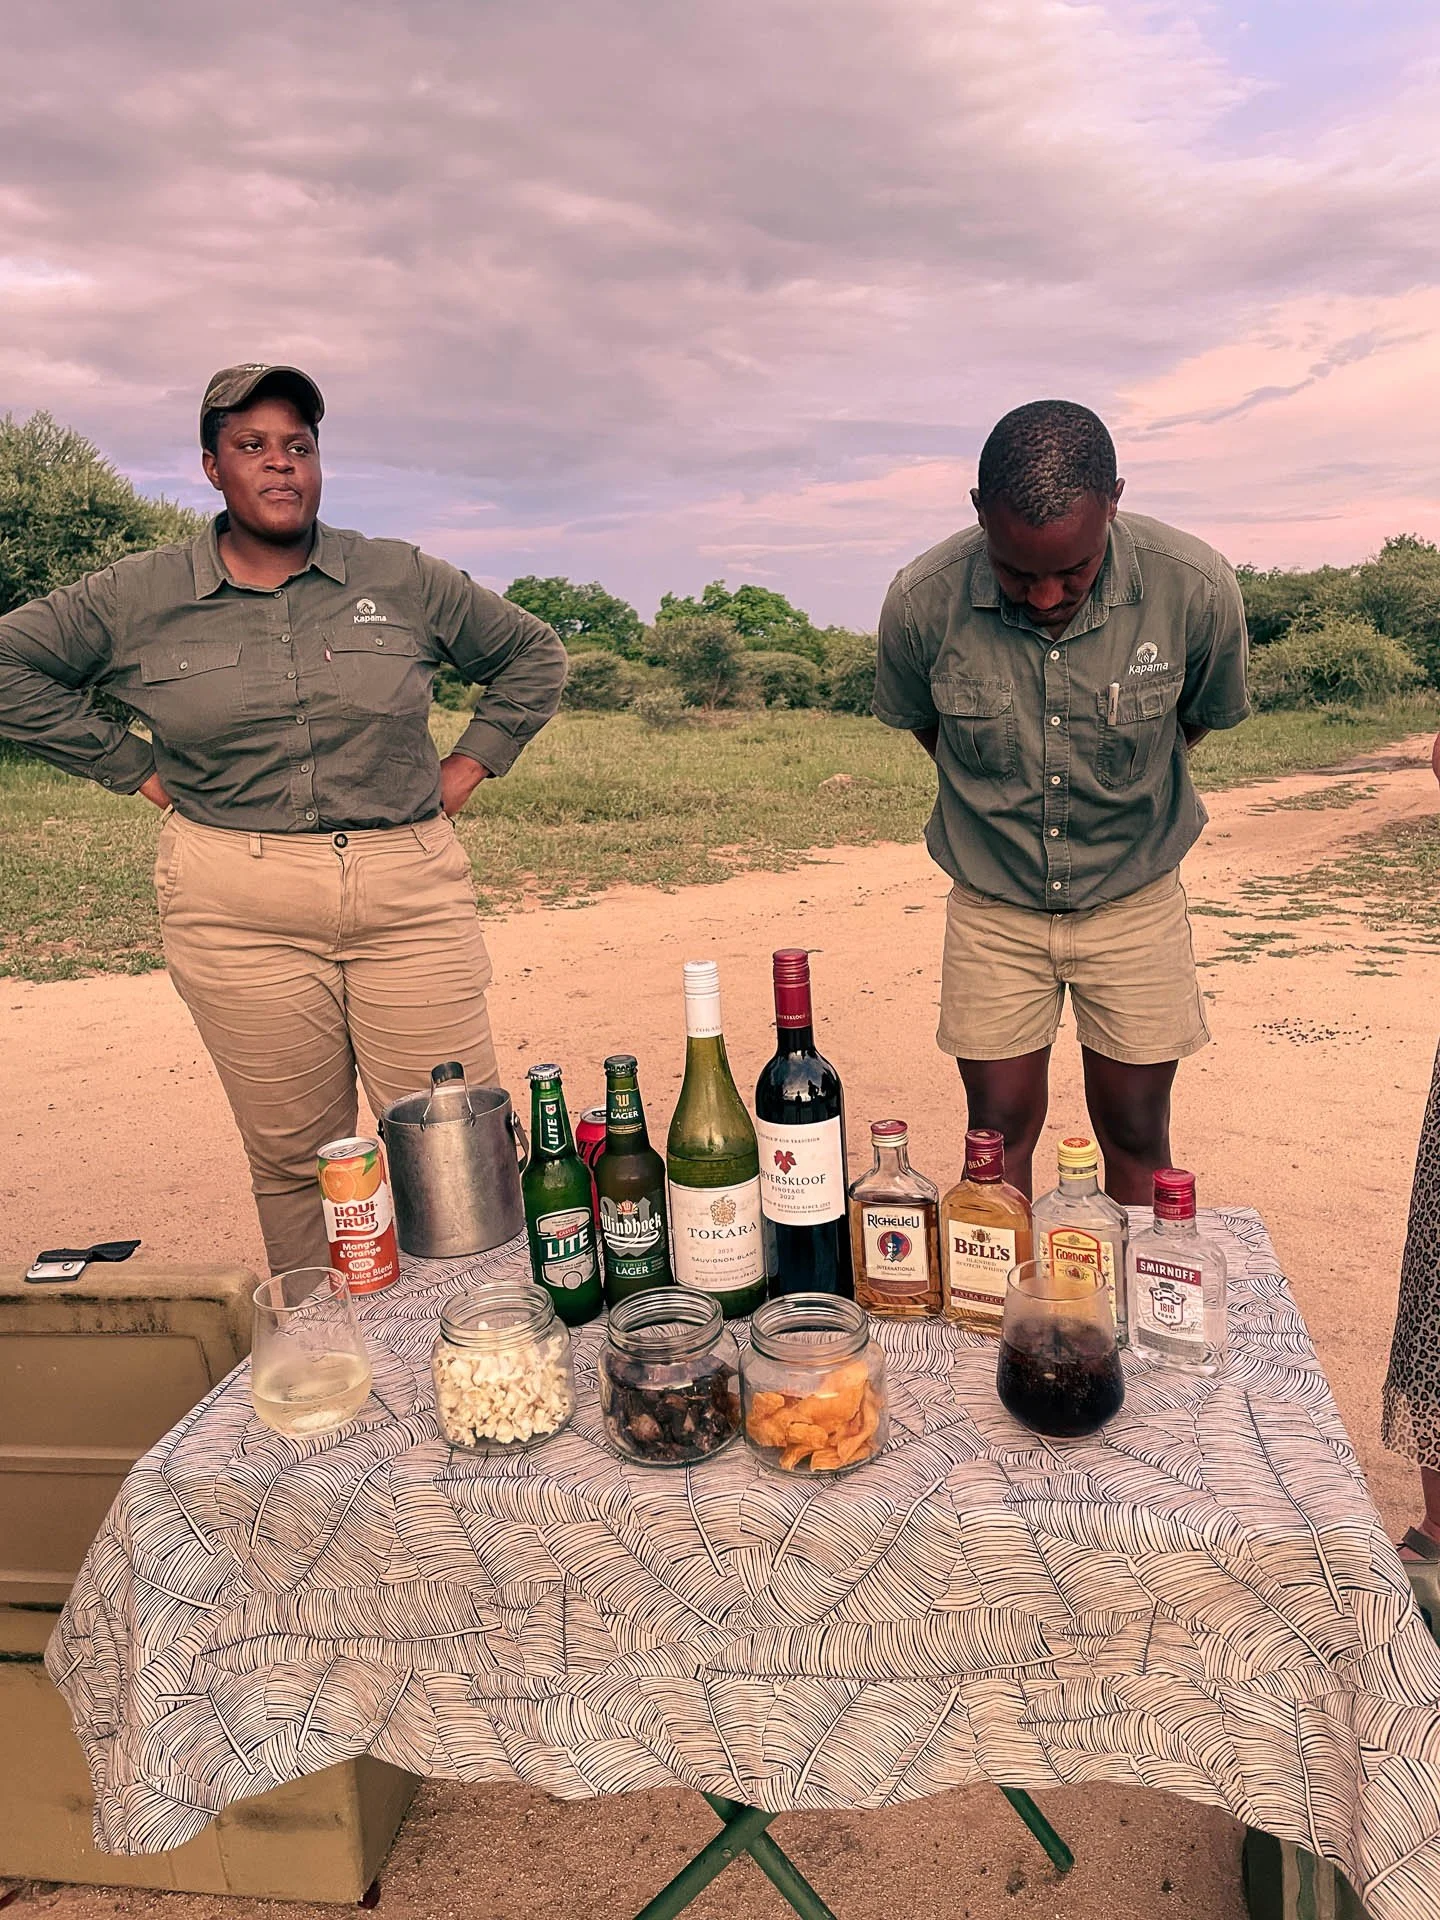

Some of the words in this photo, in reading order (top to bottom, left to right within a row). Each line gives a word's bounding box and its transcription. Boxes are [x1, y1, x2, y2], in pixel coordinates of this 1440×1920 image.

[353, 615, 387, 623] Kapama
[1128, 662, 1169, 675] Kapama
[610, 1110, 639, 1120] LAGER
[547, 1118, 559, 1145] LITE
[967, 1154, 992, 1170] BELL'S
[771, 1185, 805, 1194] PINOTAGE
[558, 1226, 577, 1237] CASTLE
[600, 1212, 662, 1239] Windhoek
[687, 1221, 757, 1240] TOKARA
[342, 1240, 376, 1251] Mango
[546, 1227, 589, 1259] LITE
[953, 1237, 1011, 1262] BELL'S
[339, 1250, 346, 1259] &
[346, 1246, 382, 1259] Orange
[691, 1256, 735, 1264] SAUVIGNON
[737, 1248, 758, 1261] BLANC
[1055, 1248, 1096, 1265] GORDON'S
[350, 1261, 372, 1270] 100%
[350, 1271, 371, 1280] Juice
[372, 1261, 393, 1275] Blend
[615, 1266, 649, 1276] LAGER
[1139, 1260, 1197, 1282] SMIRNOFF
[1159, 1302, 1176, 1314] 1818
